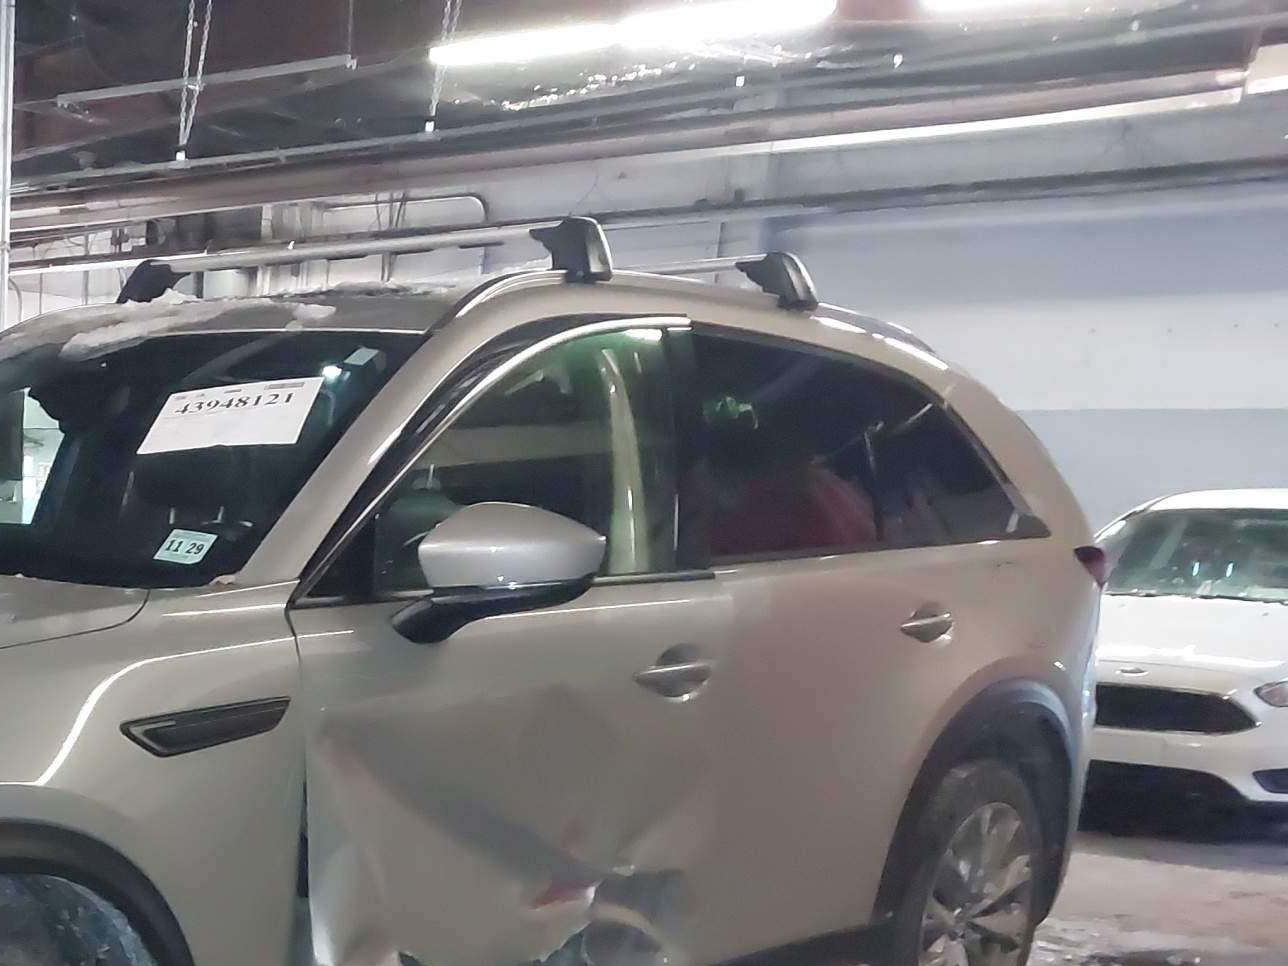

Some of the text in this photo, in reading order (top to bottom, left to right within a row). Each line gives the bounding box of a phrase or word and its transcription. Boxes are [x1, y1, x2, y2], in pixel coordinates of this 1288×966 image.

[175, 392, 294, 415] 43948121
[165, 539, 205, 555] 11 29
